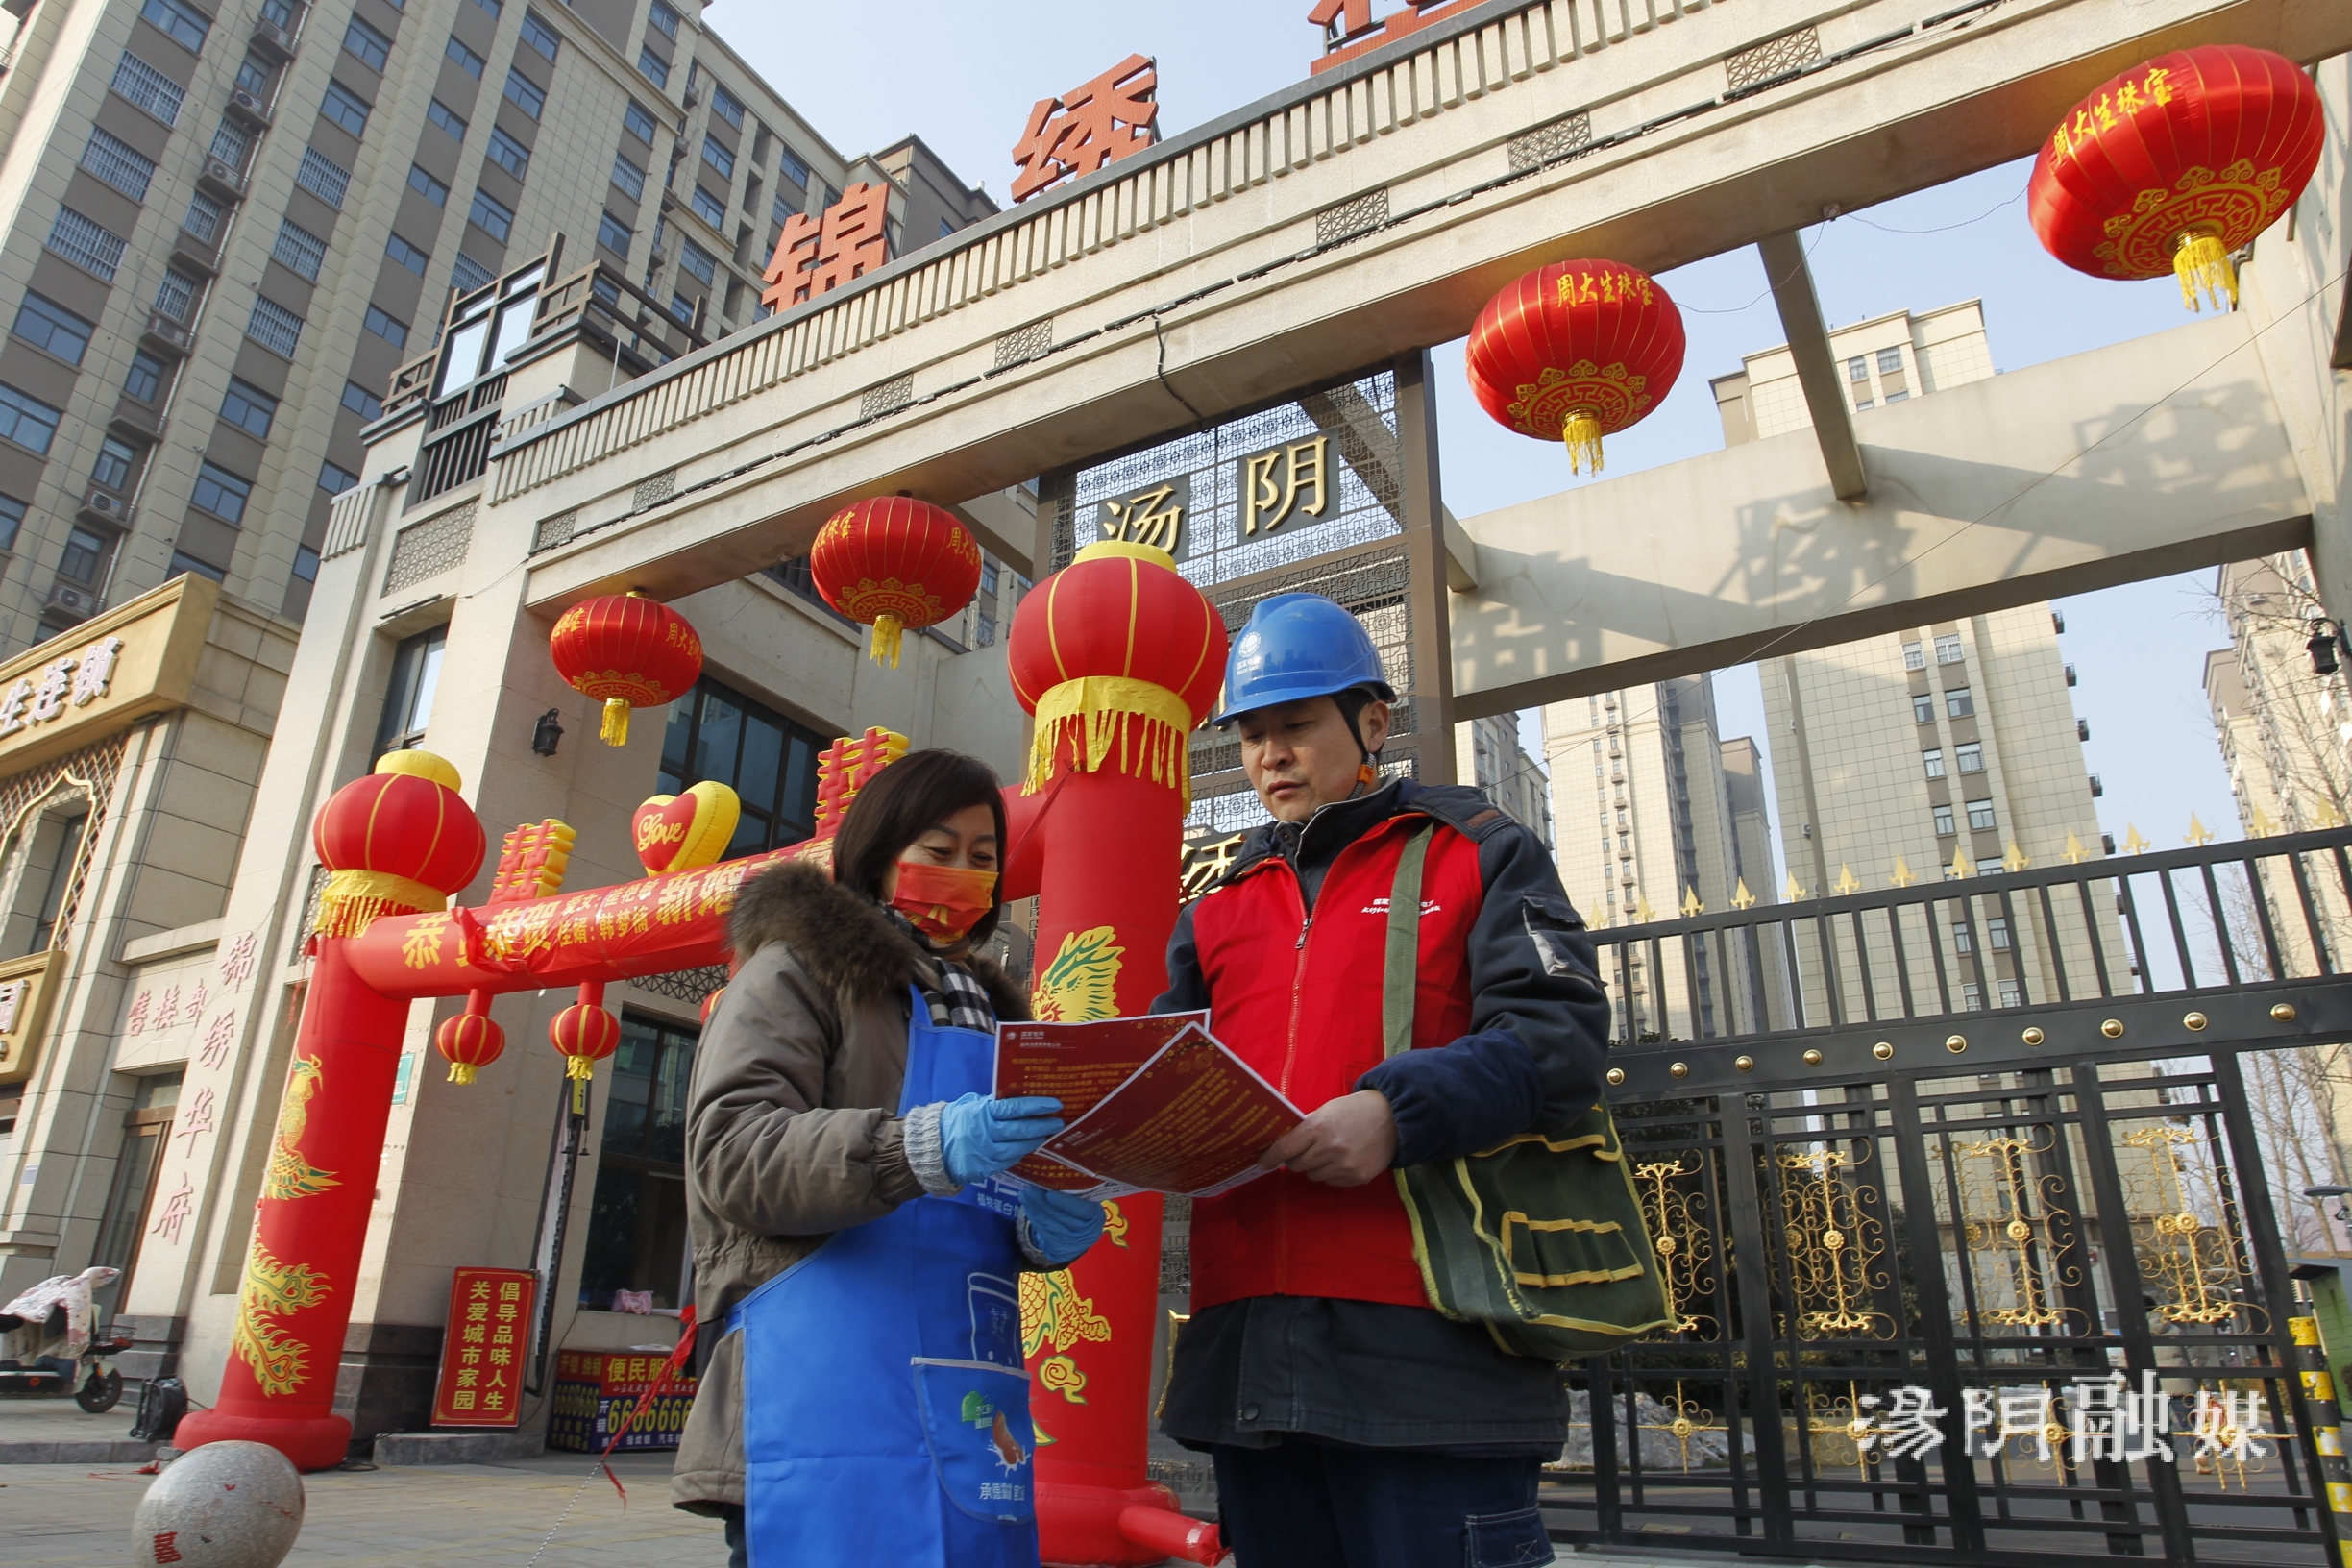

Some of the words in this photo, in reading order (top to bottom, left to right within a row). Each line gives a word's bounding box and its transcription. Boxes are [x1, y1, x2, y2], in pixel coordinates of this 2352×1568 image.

[2054, 68, 2173, 165] 周大生珠宝
[1557, 270, 1654, 307] 周大生珠宝
[1103, 435, 1328, 554] 汤阴
[637, 813, 685, 852] Love
[152, 930, 257, 1245] 锦绣华府
[453, 1281, 491, 1410] 关爱城市家园
[482, 1281, 521, 1411] 倡导品味人生
